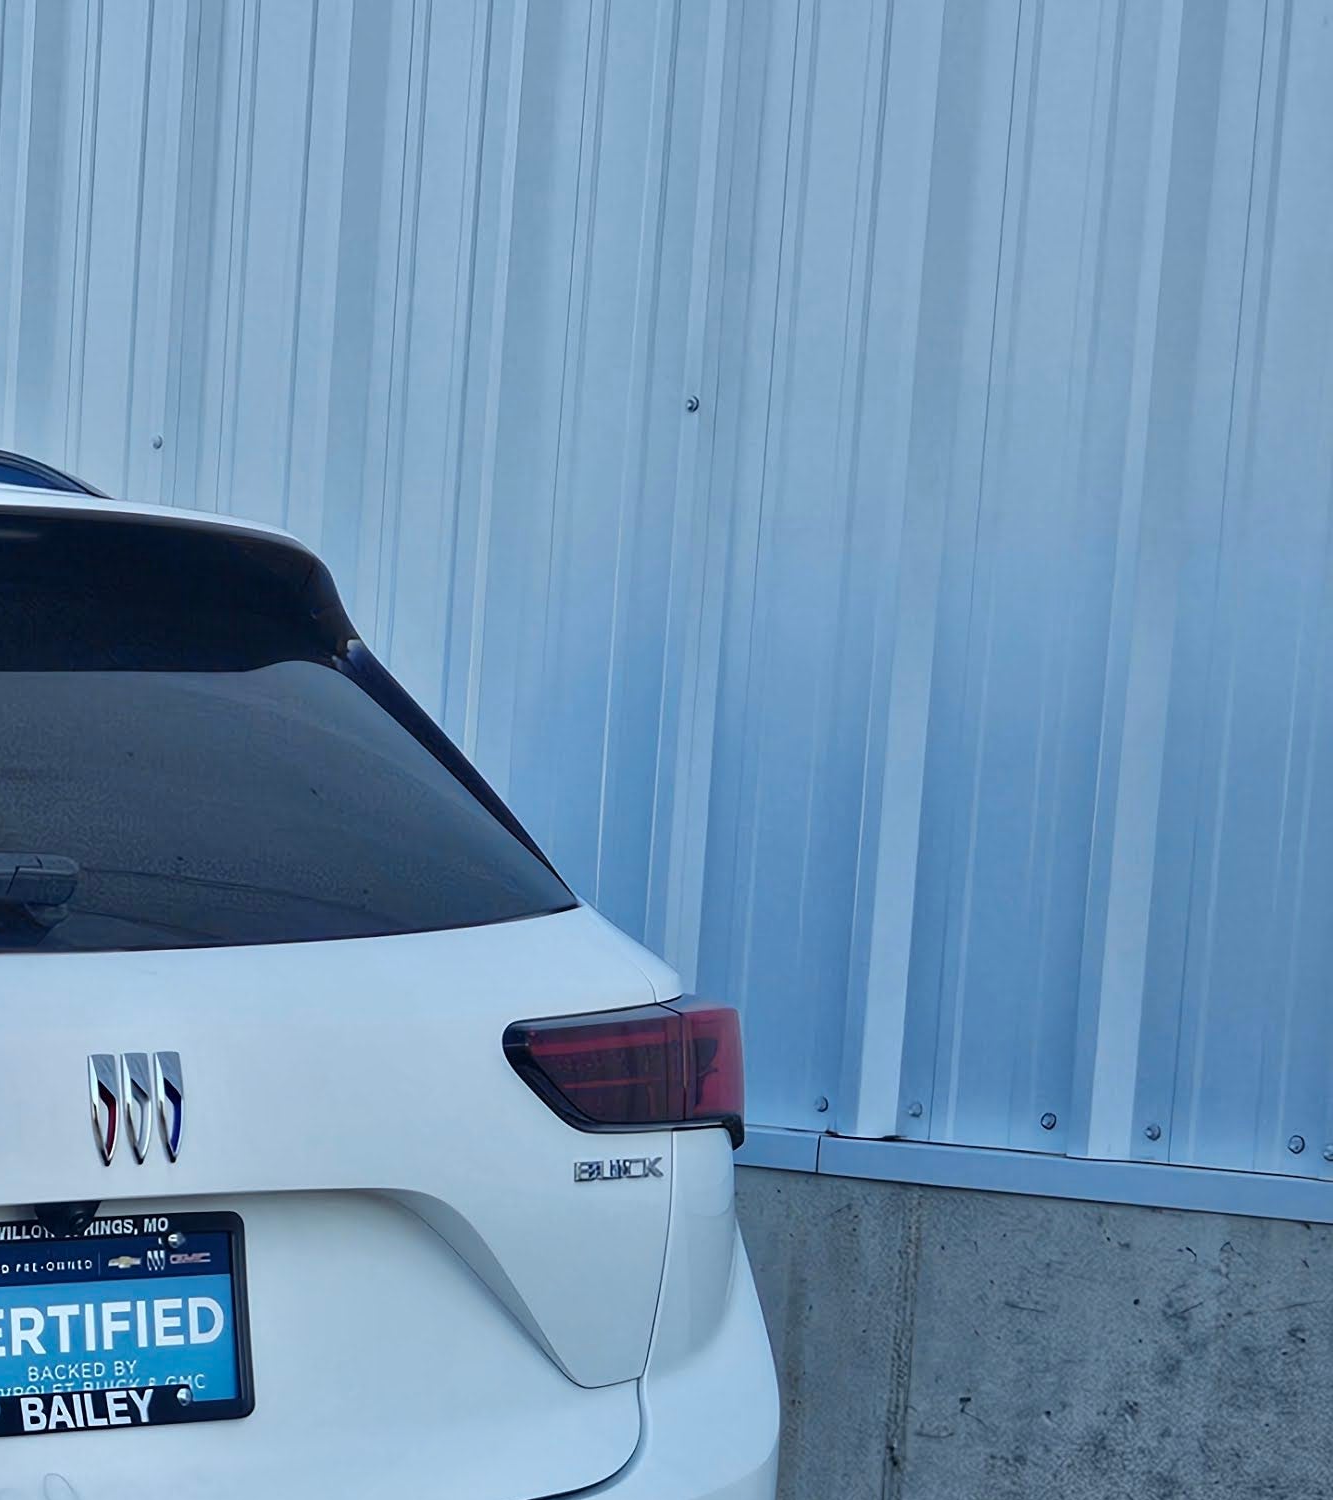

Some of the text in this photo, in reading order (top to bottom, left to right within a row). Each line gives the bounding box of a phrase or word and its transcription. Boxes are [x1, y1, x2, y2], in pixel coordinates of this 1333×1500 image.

[573, 1156, 664, 1182] BUICK
[143, 1216, 169, 1233] MO
[27, 1359, 138, 1383] BACKED BY
[19, 1388, 154, 1432] BAILEY
